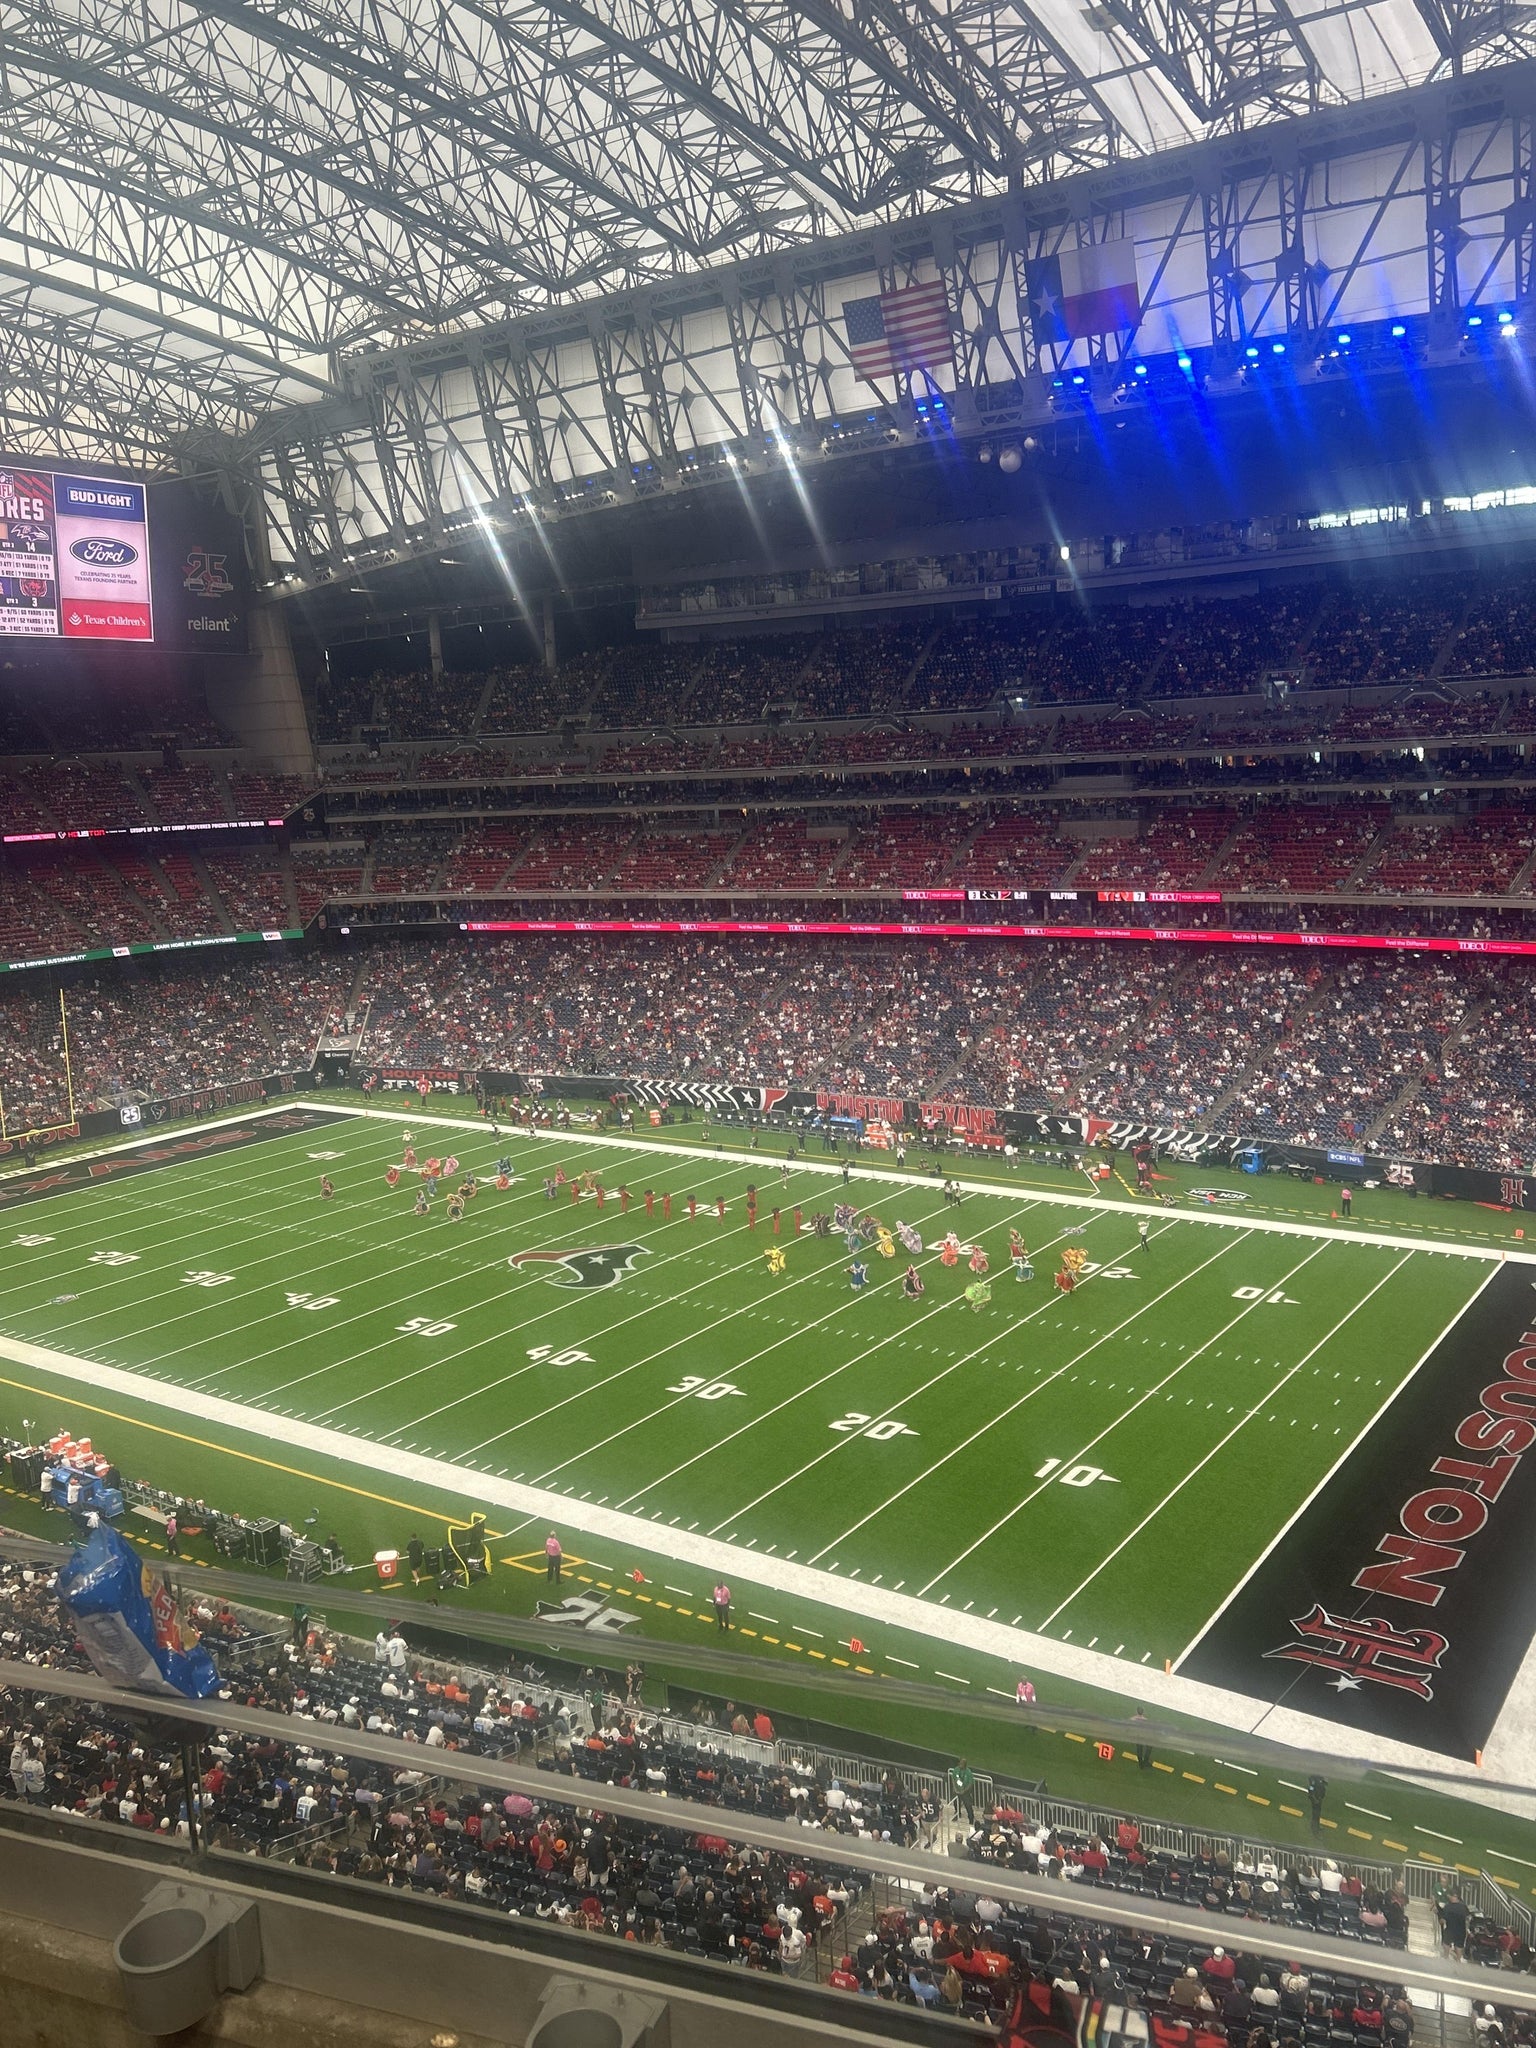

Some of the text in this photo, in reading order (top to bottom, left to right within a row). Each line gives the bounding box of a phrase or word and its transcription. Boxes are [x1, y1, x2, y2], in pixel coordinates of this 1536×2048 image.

[70, 490, 132, 507] BUD LIGHT
[26, 542, 35, 552] 14
[84, 541, 125, 562] Ford
[32, 598, 38, 607] 3
[84, 615, 146, 626] Texas Children's
[188, 617, 230, 632] reliant
[1301, 936, 1327, 944] TDECU
[1459, 942, 1488, 950] TDECU
[382, 1069, 459, 1080] HOUSTON
[123, 1108, 138, 1123] 25
[919, 1103, 996, 1131] TEXANS
[1501, 1178, 1524, 1207] H
[88, 1251, 141, 1266] 20
[178, 1270, 236, 1287] 30
[286, 1292, 341, 1310] 40
[395, 1317, 458, 1336] 50
[526, 1344, 583, 1366] 40
[665, 1376, 737, 1400] 30
[828, 1412, 908, 1440] 20
[1351, 1320, 1536, 1607] OUSTON
[1033, 1458, 1105, 1487] 10
[382, 1564, 392, 1573] G
[158, 1594, 175, 1632] PEA
[392, 1646, 399, 1656] 7
[1101, 1745, 1110, 1759] G
[1143, 1946, 1151, 1959] 7
